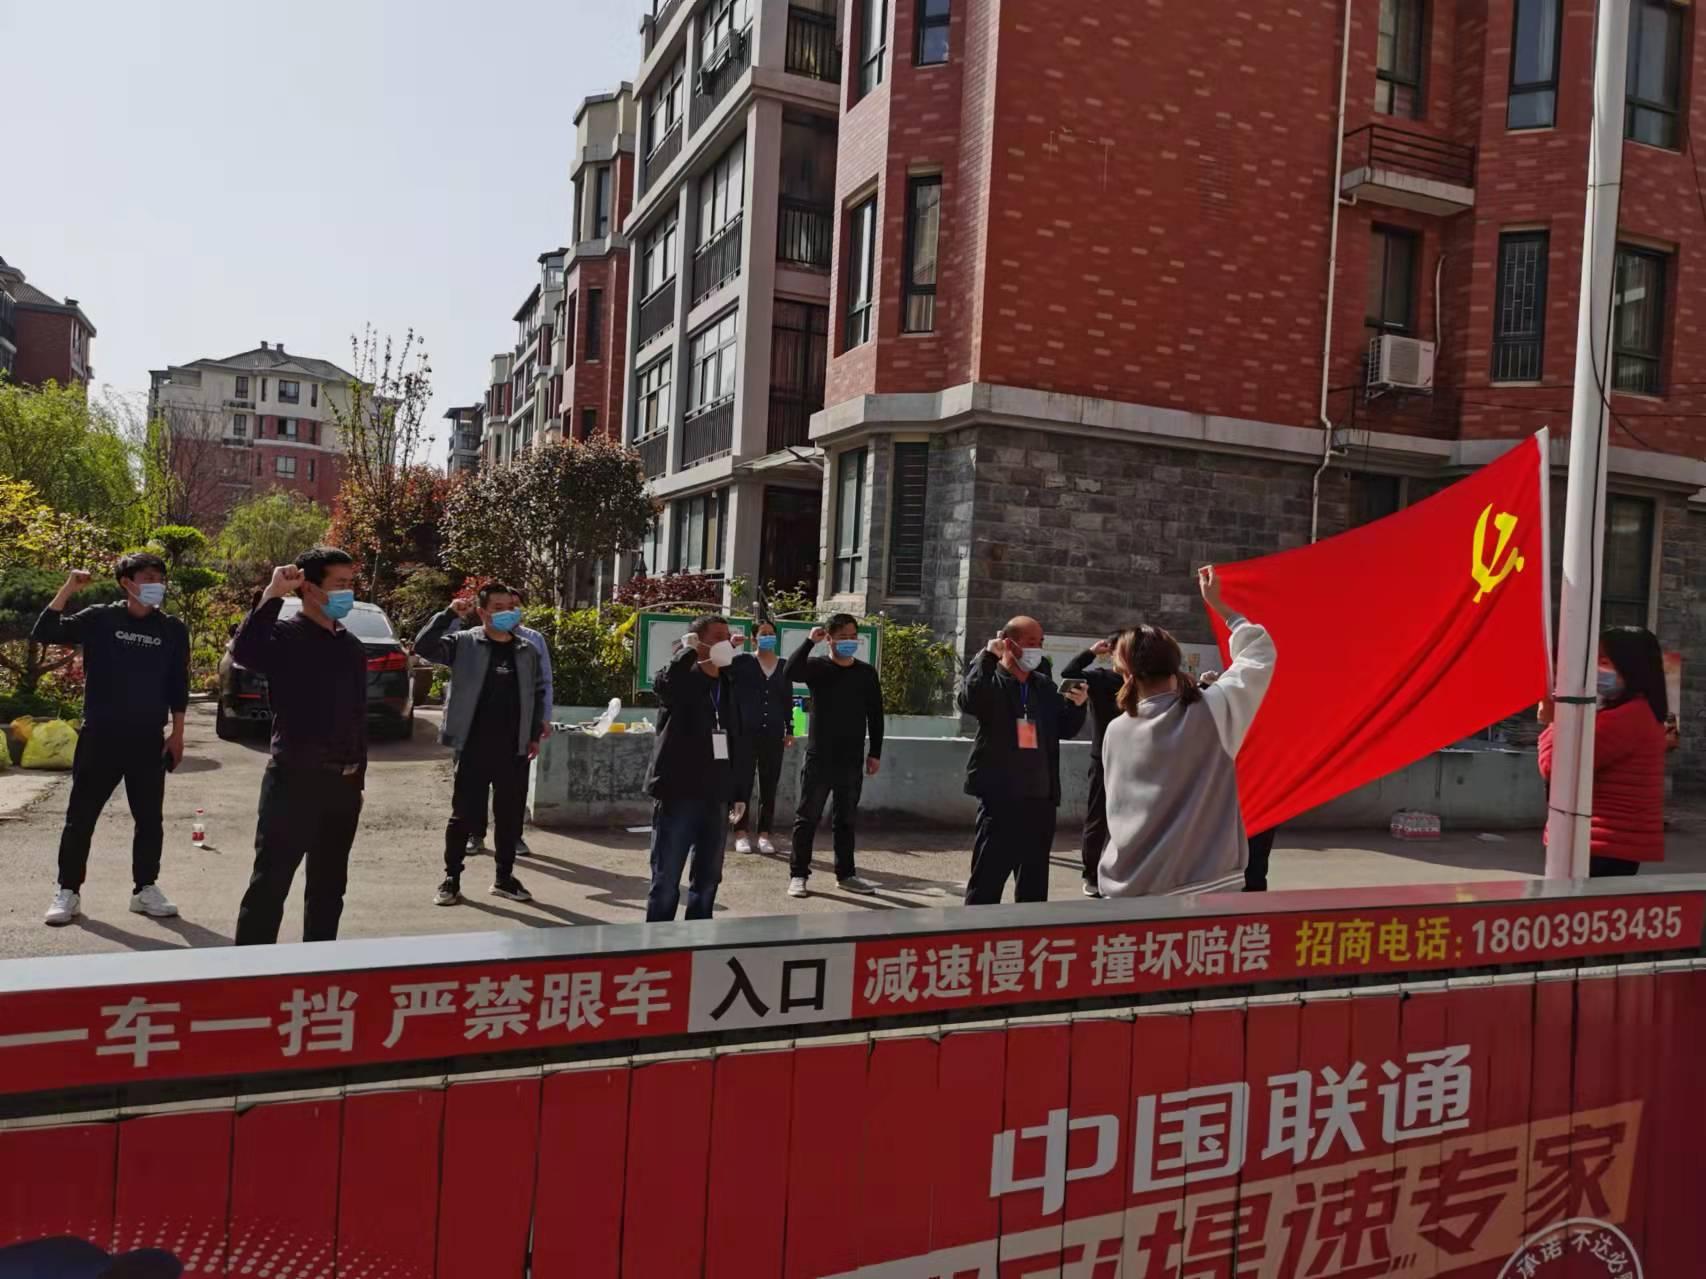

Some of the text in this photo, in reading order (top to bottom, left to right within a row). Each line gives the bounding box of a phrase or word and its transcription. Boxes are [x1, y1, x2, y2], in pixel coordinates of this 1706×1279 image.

[863, 922, 1271, 1004] 减速慢行 撞坏赔偿
[1471, 905, 1682, 955] 18603953435
[0, 966, 673, 1068] 一车一挡 严禁跟车
[709, 956, 827, 1020] 入口
[989, 1044, 1472, 1216] 中国联通
[928, 1119, 1630, 1279] 提速专家
